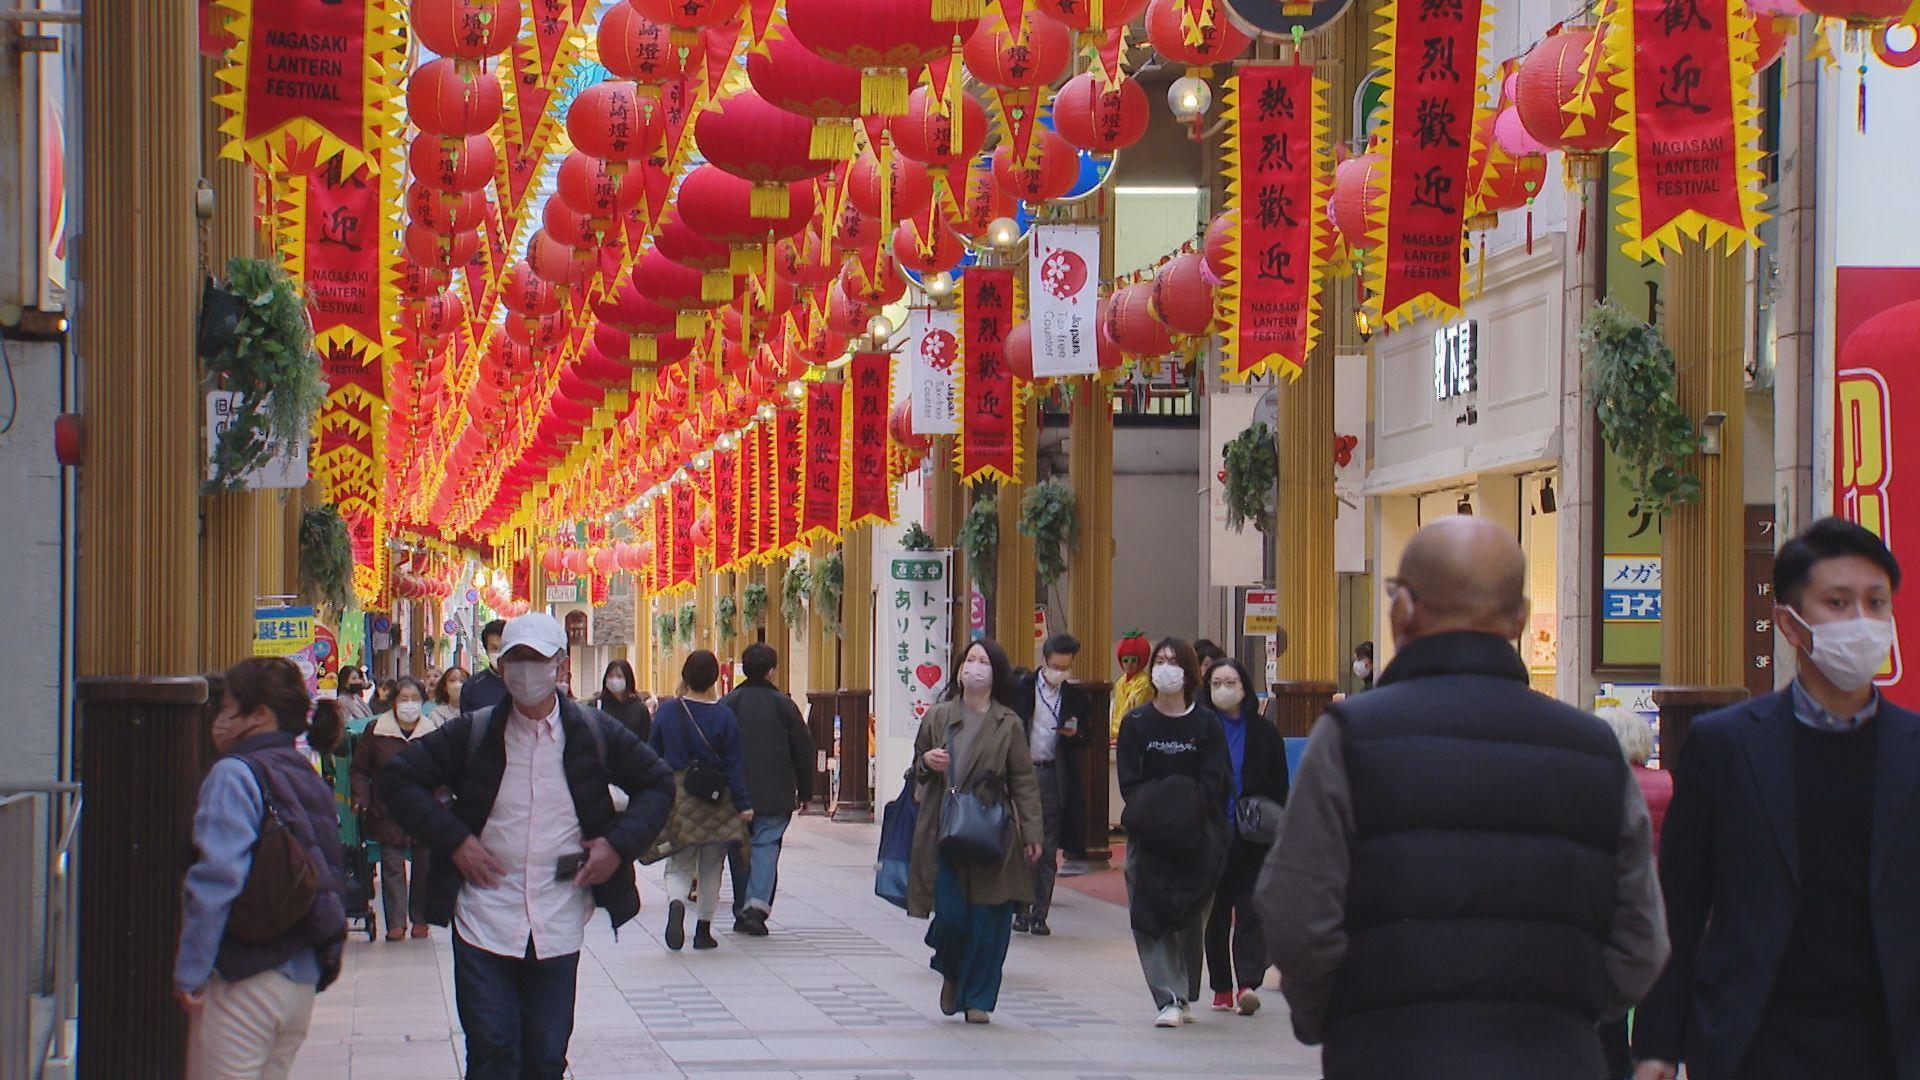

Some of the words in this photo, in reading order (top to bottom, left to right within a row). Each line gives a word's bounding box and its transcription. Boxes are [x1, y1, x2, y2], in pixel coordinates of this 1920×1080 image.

[266, 29, 347, 53] NAGASAKI
[268, 54, 342, 77] LANTERN
[266, 78, 342, 102] FESTIVAL
[606, 91, 629, 152] 長崎燈會
[1652, 137, 1724, 156] NAGASAKI
[1656, 159, 1719, 176] LANTERN
[1255, 79, 1299, 285] 熱烈歡迎
[1656, 178, 1720, 197] FESTIVAL
[312, 269, 368, 283] NAGASAKI
[1251, 302, 1300, 313] NAGASAKI
[1253, 315, 1297, 328] LANTERN
[1253, 330, 1297, 342] FESTIVAL
[976, 280, 1004, 419] 熱烈歡迎
[858, 366, 881, 479] 熱烈歡迎
[1756, 583, 1771, 596] 1F
[920, 589, 938, 654] トマト
[895, 587, 916, 693] あります。
